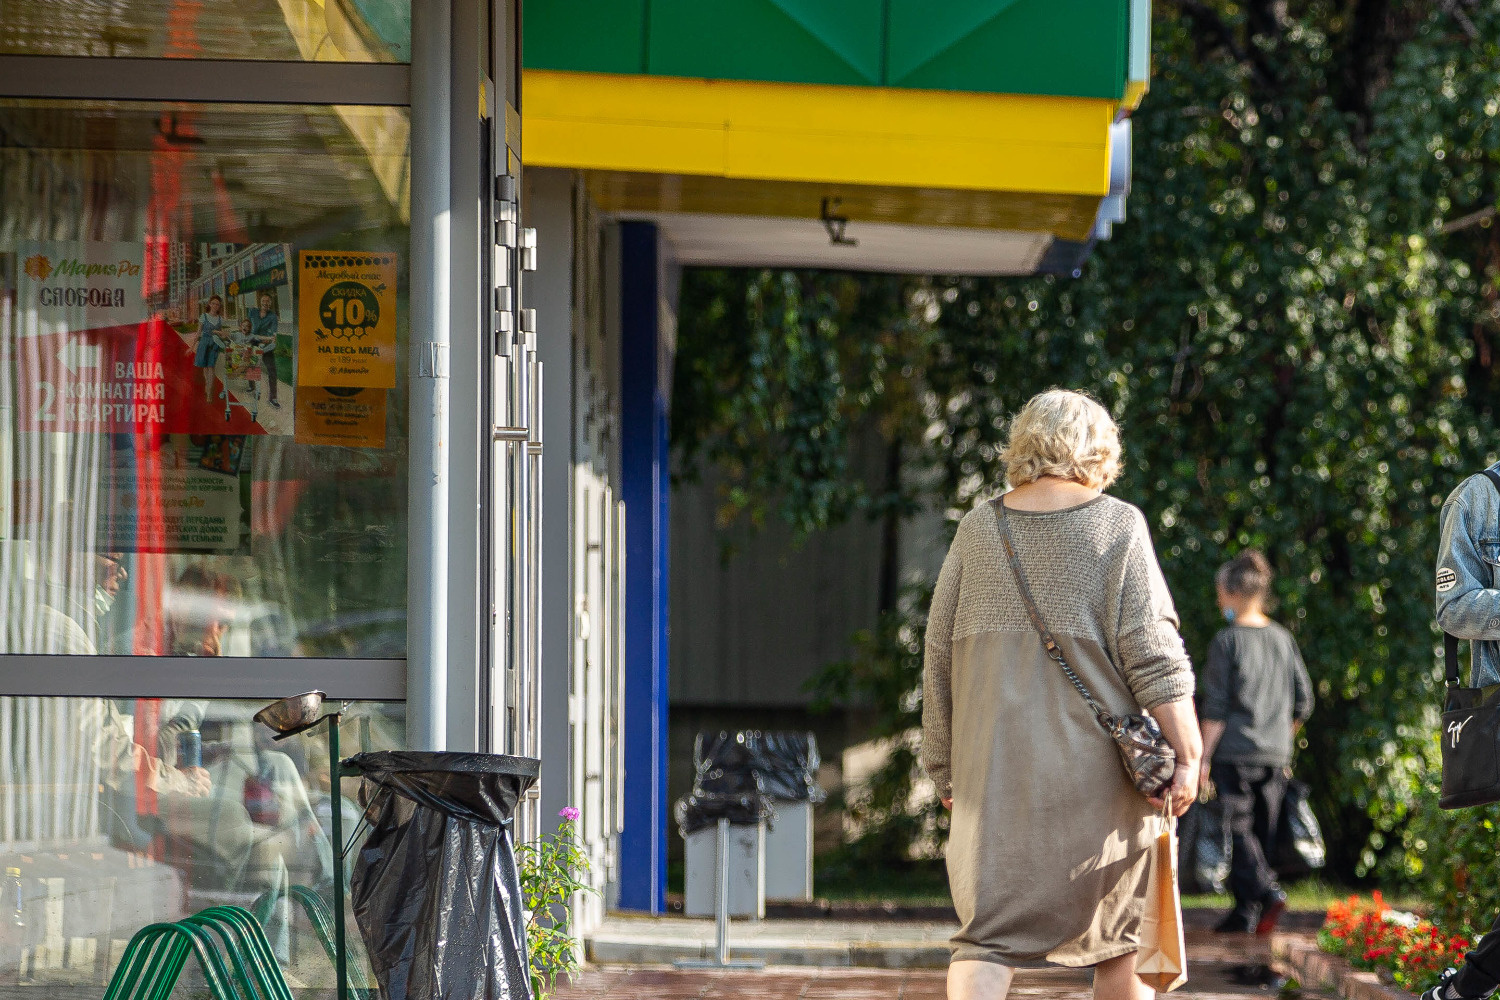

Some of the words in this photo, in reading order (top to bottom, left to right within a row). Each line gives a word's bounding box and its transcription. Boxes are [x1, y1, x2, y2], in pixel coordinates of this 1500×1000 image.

[332, 288, 367, 297] СКИДКА
[317, 345, 332, 354] НА
[333, 346, 356, 354] ВЕСЬ
[358, 346, 380, 357] МЕД
[115, 362, 165, 380] ВАША
[65, 403, 165, 424] КВАРТИРА!
